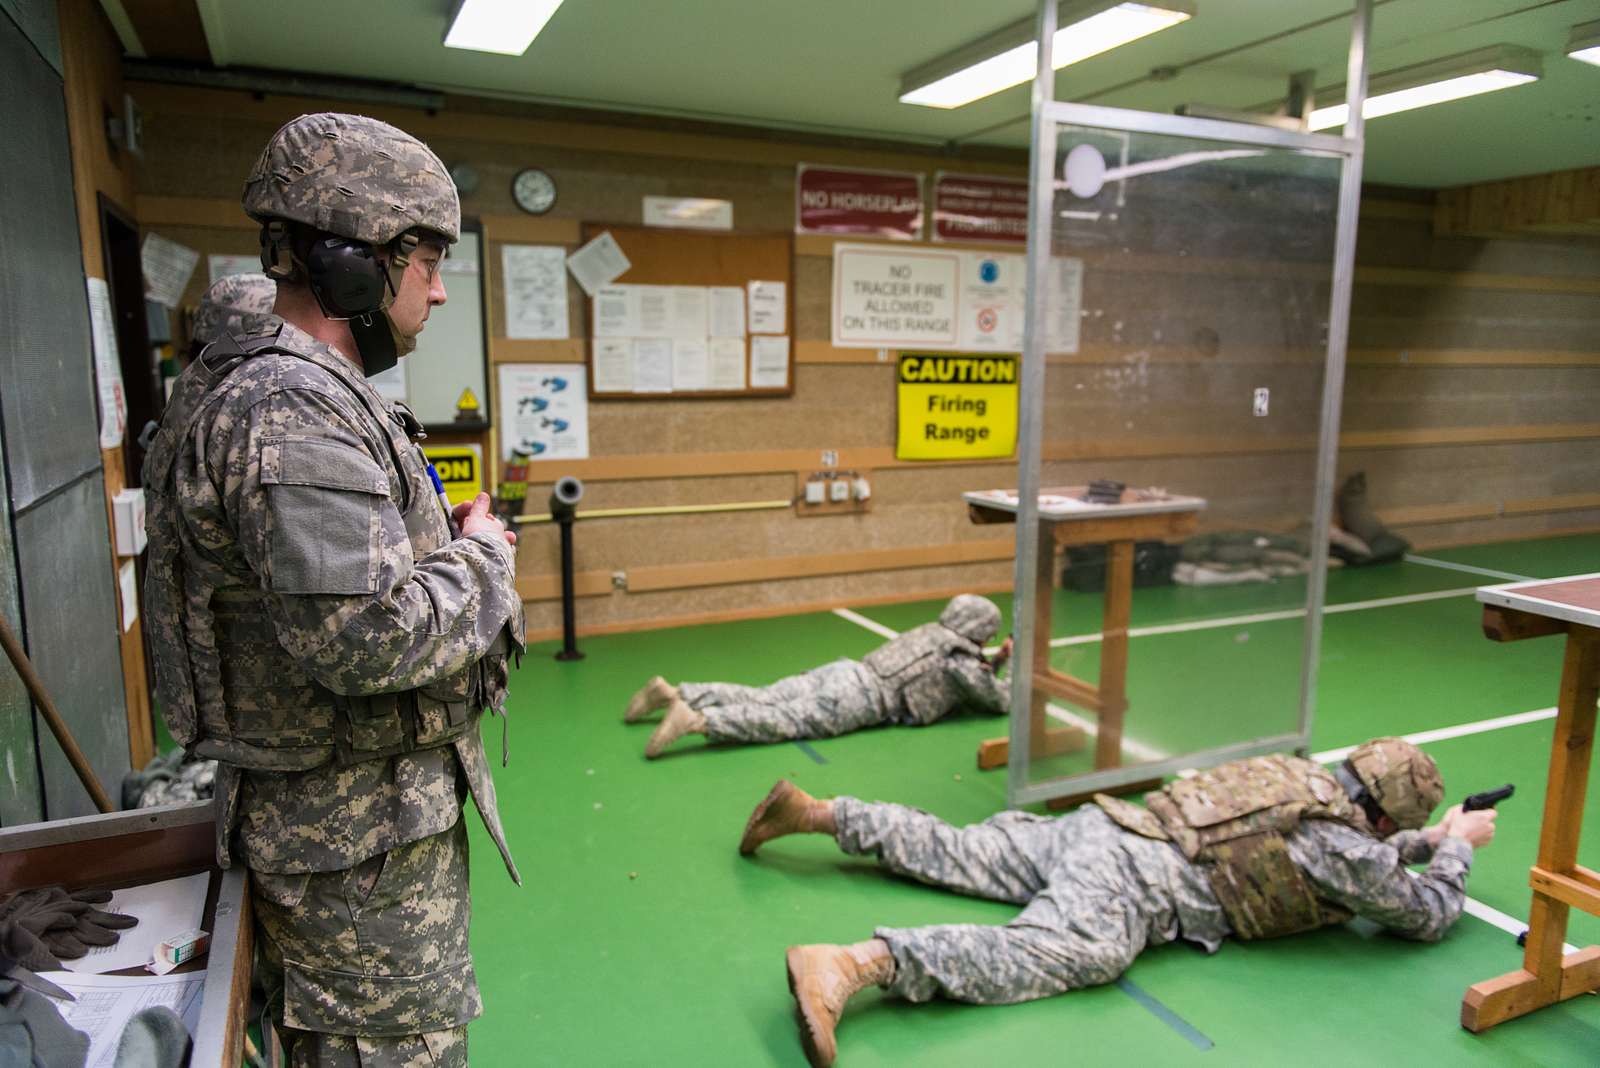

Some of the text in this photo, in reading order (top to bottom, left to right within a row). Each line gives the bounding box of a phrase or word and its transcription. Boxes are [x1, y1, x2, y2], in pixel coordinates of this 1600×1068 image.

[802, 190, 828, 209] NO
[831, 191, 924, 213] HORSEPLAY
[889, 264, 912, 279] NO
[853, 280, 945, 299] TRACER FIRE
[864, 299, 934, 316] ALLOWED
[843, 316, 950, 333] ON THIS RANGE
[901, 358, 1015, 382] CAUTION
[927, 394, 987, 417] Firing
[925, 423, 991, 445] Range
[435, 460, 471, 481] ON
